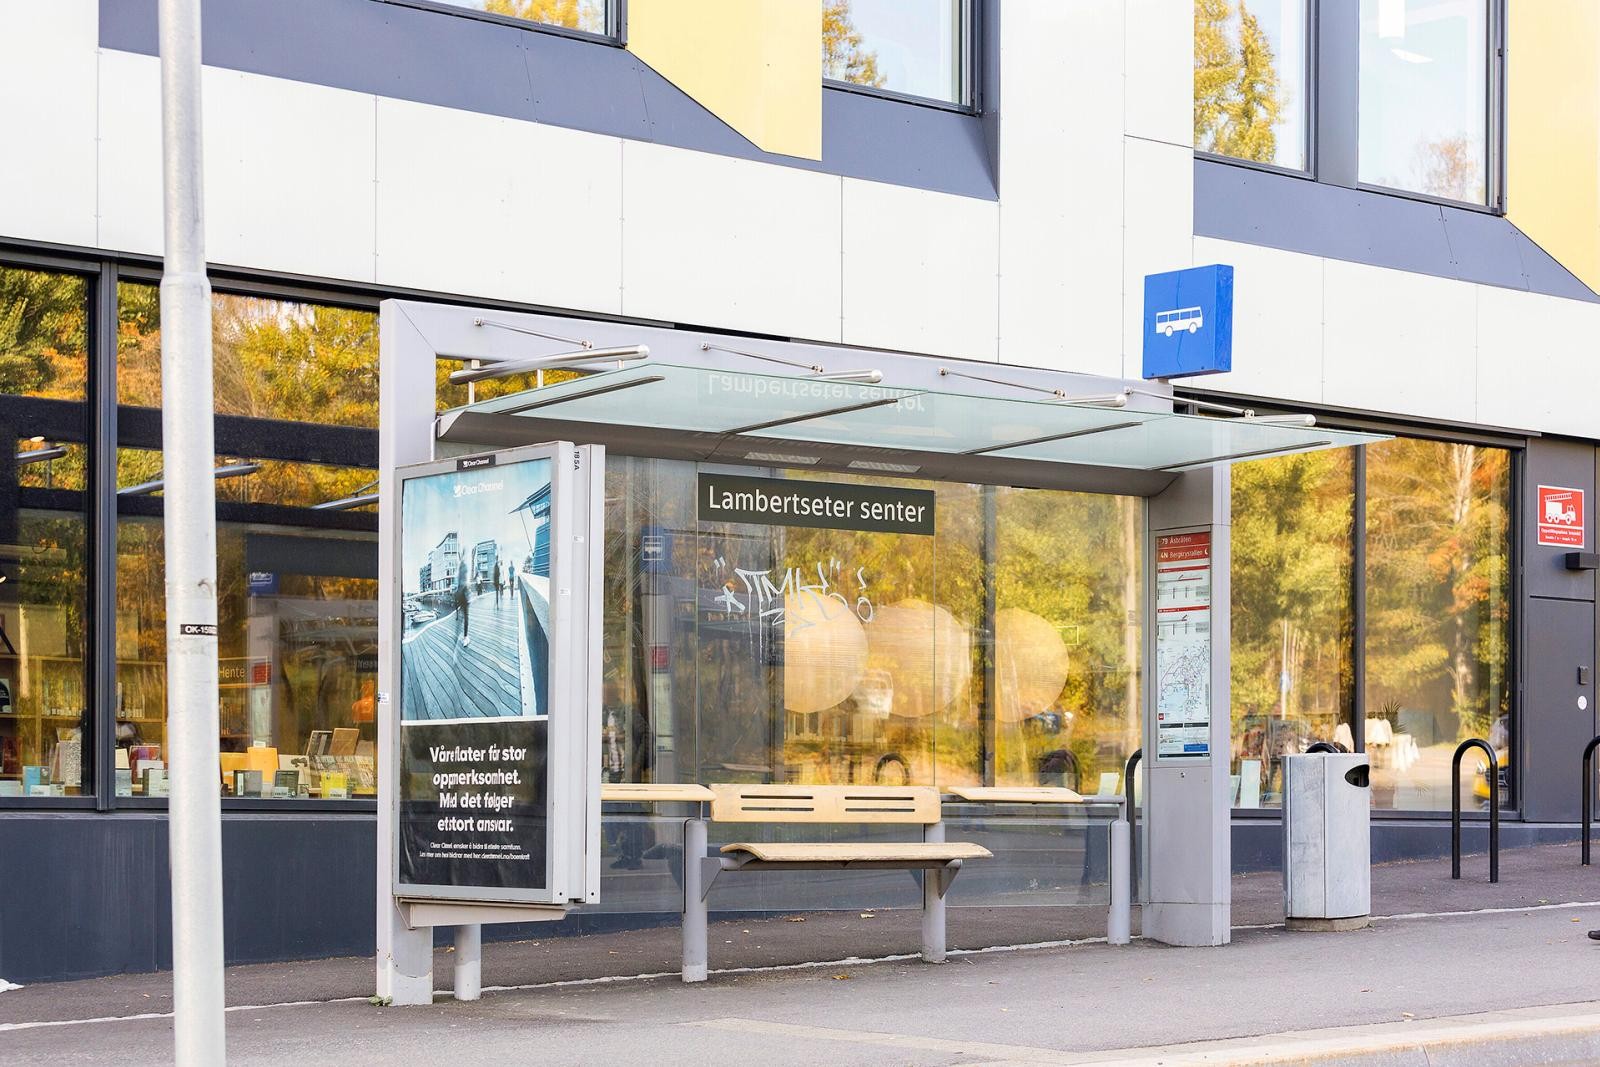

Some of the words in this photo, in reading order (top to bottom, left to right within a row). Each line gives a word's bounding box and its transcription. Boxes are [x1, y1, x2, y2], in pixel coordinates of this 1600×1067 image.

[708, 485, 854, 518] Lambertseter
[860, 500, 925, 523] senter
[502, 746, 527, 761] stor
[460, 792, 481, 809] det
[484, 792, 514, 812] følger
[476, 819, 514, 832] ansvar.
